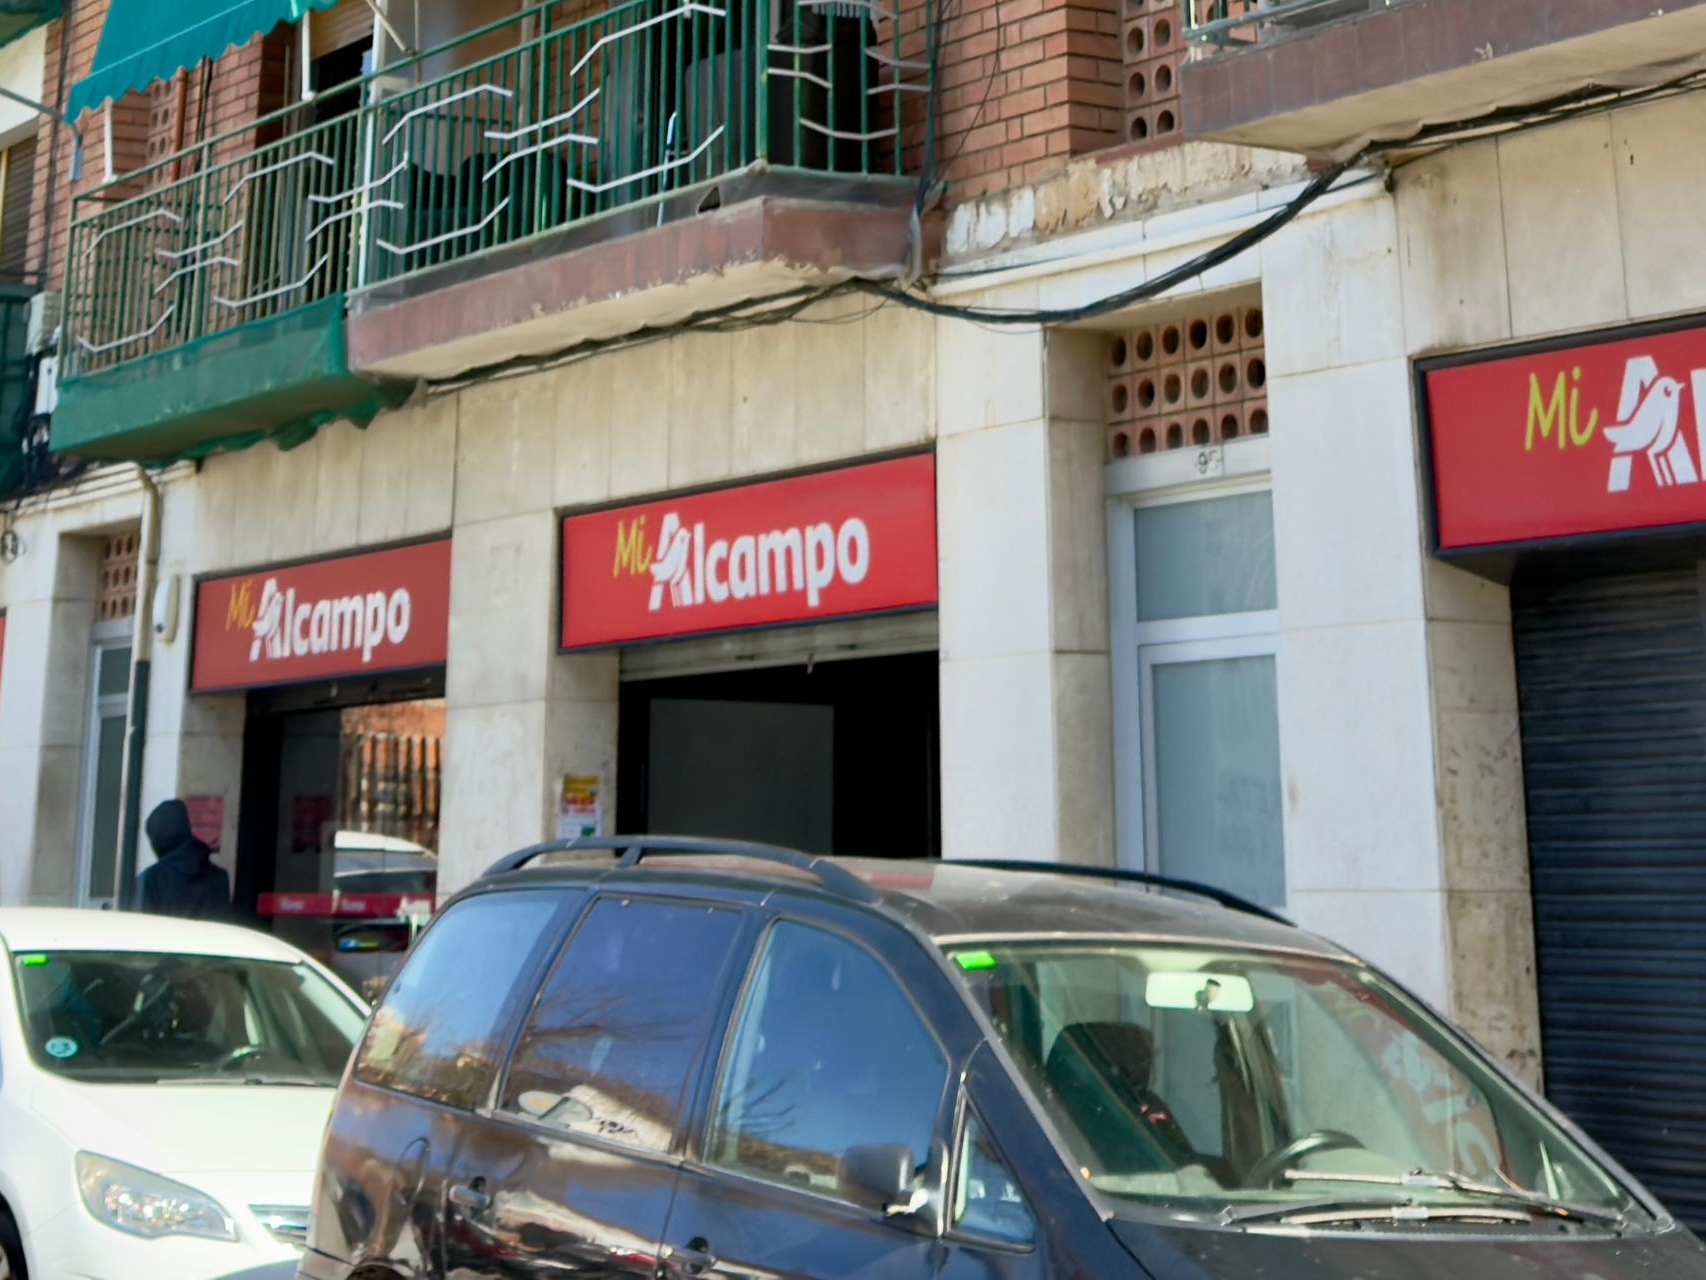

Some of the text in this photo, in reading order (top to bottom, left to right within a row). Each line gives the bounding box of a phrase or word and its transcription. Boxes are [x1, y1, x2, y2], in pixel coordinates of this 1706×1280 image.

[1524, 366, 1597, 451] Mi
[613, 512, 870, 611] Mi Alcampo
[225, 577, 411, 663] Mi Alcampo
